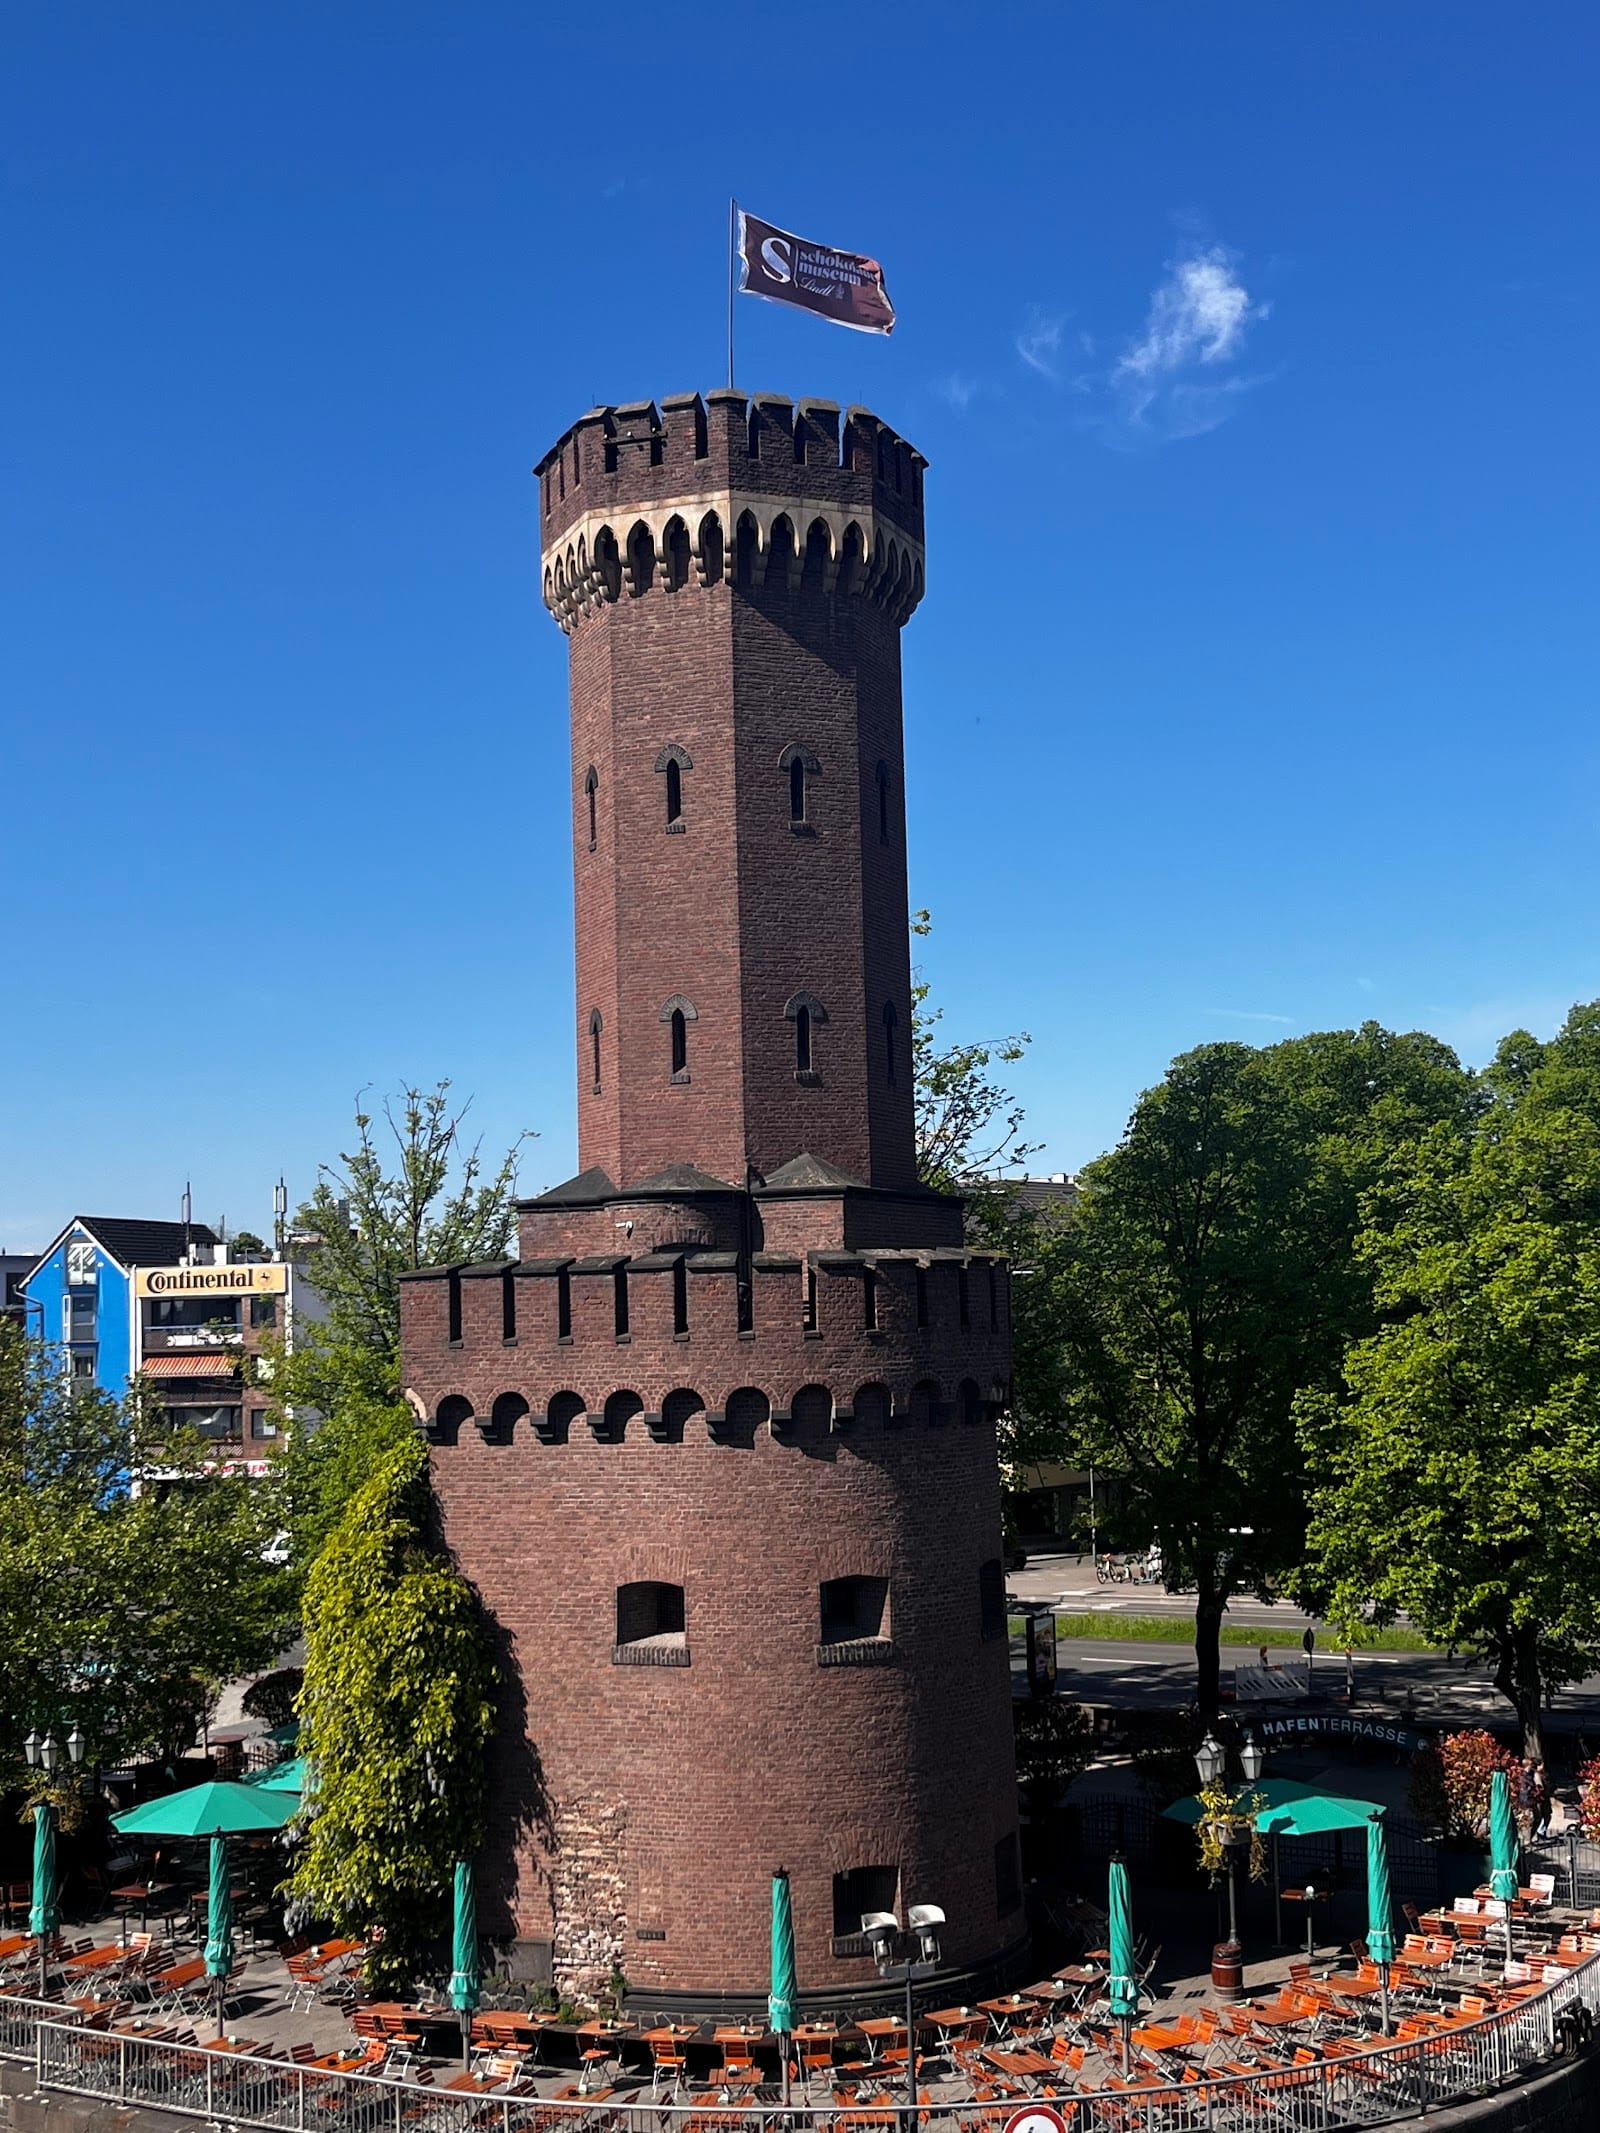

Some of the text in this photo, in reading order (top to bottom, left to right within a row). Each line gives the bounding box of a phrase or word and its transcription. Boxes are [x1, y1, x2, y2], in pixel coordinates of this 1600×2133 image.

[761, 237, 792, 284] S
[798, 262, 862, 287] museum
[146, 1268, 255, 1294] Continental
[1262, 1717, 1408, 1745] HAFENTERRASSE
